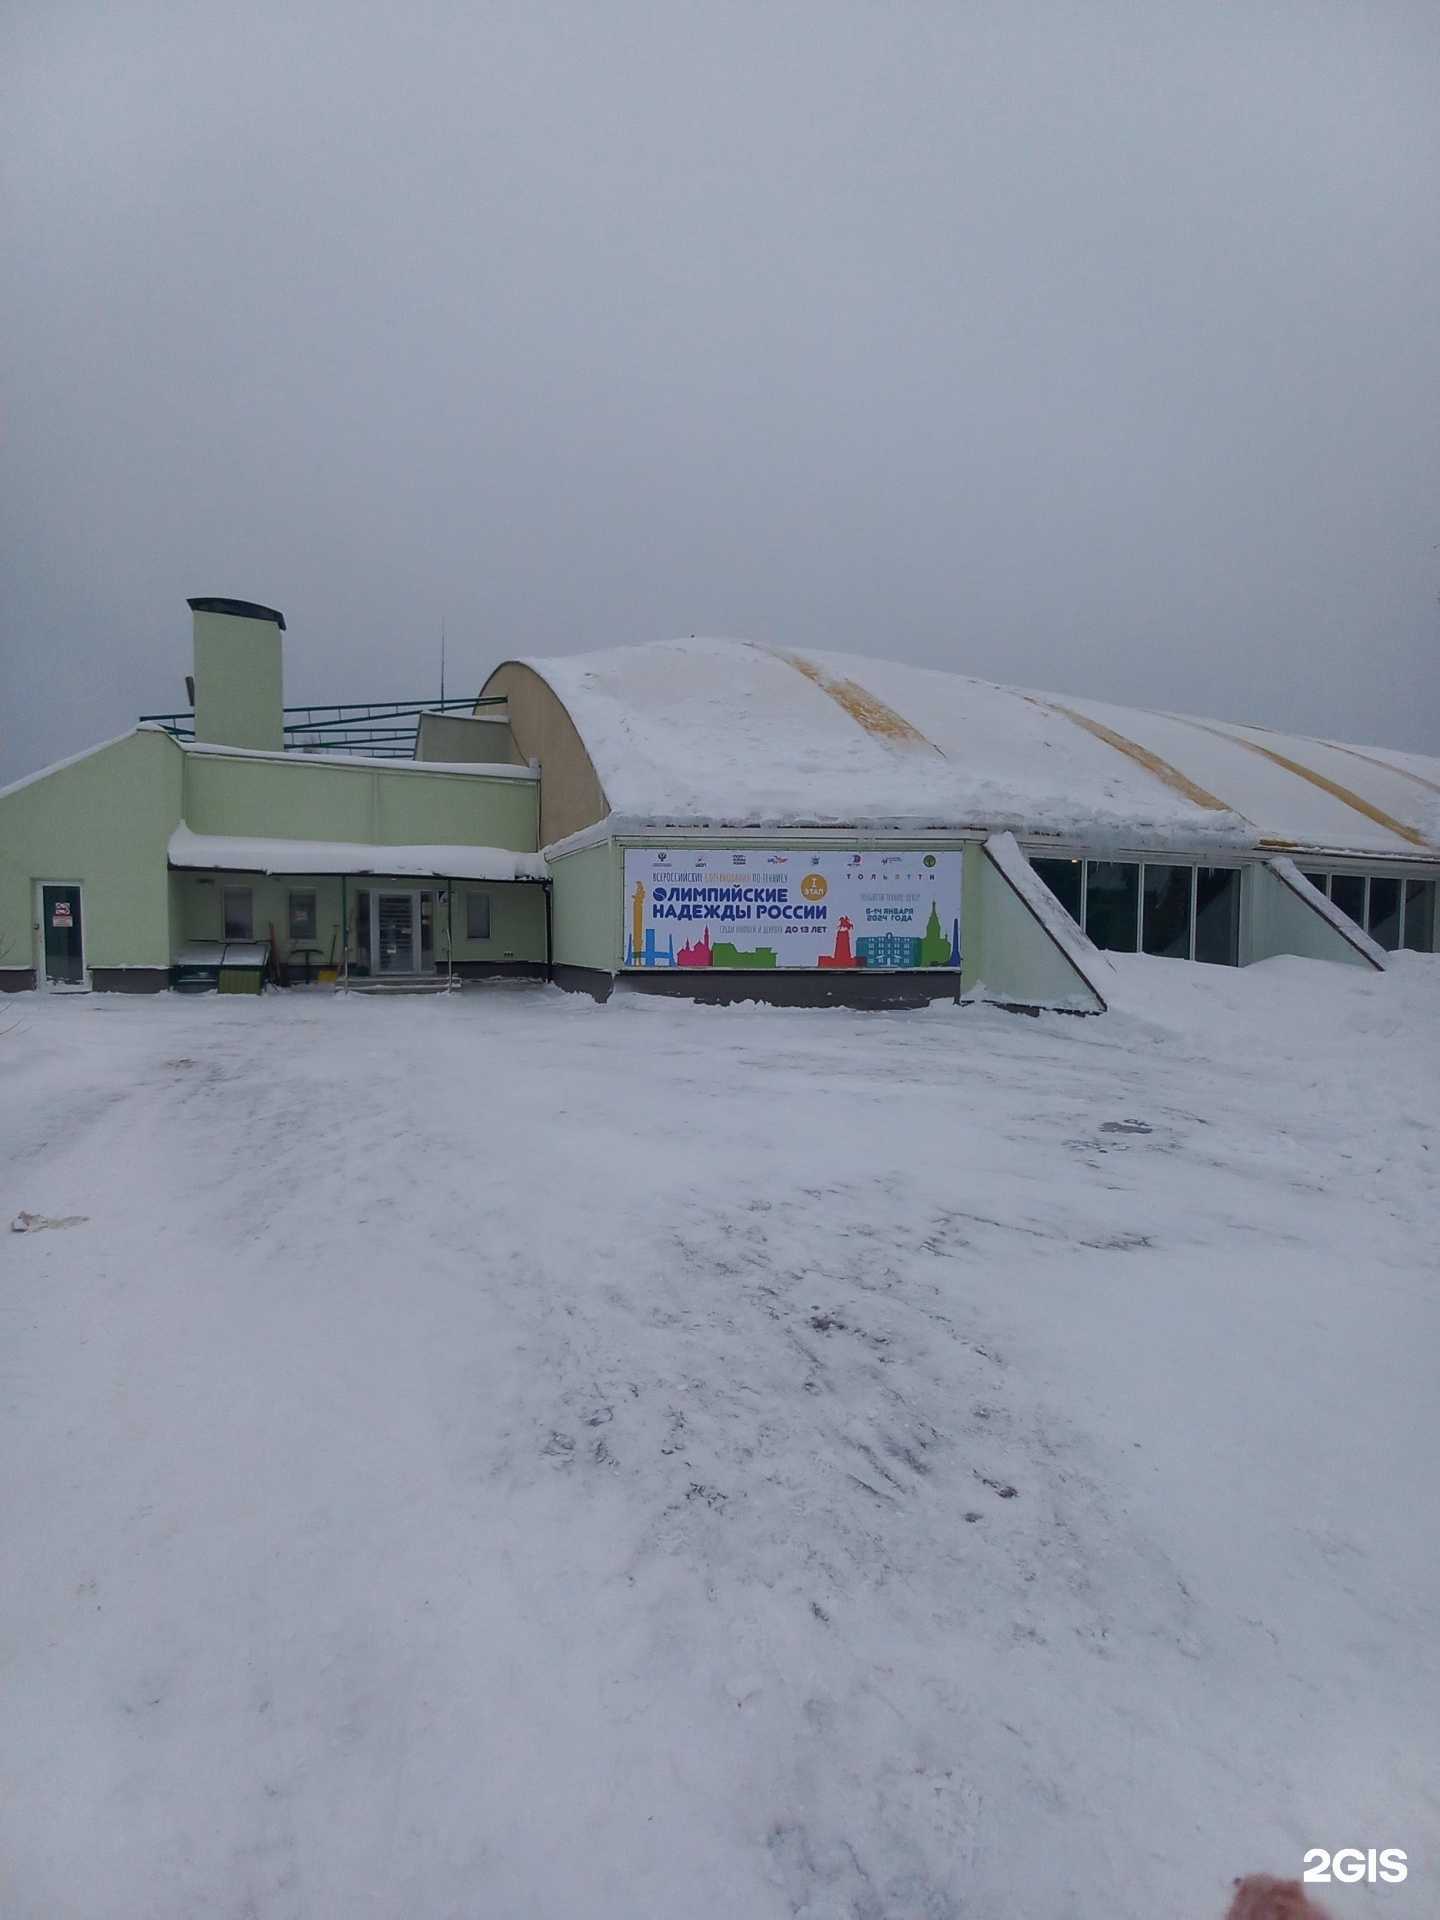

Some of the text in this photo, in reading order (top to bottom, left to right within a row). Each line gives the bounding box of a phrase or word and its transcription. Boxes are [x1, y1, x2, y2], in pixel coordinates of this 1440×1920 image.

[652, 885, 788, 902] ОЛИМПИЙСКИЕ
[804, 888, 824, 896] ЭТАП
[652, 904, 827, 921] НАДЕЖДЫ РОССИИ
[784, 926, 799, 934] ДО
